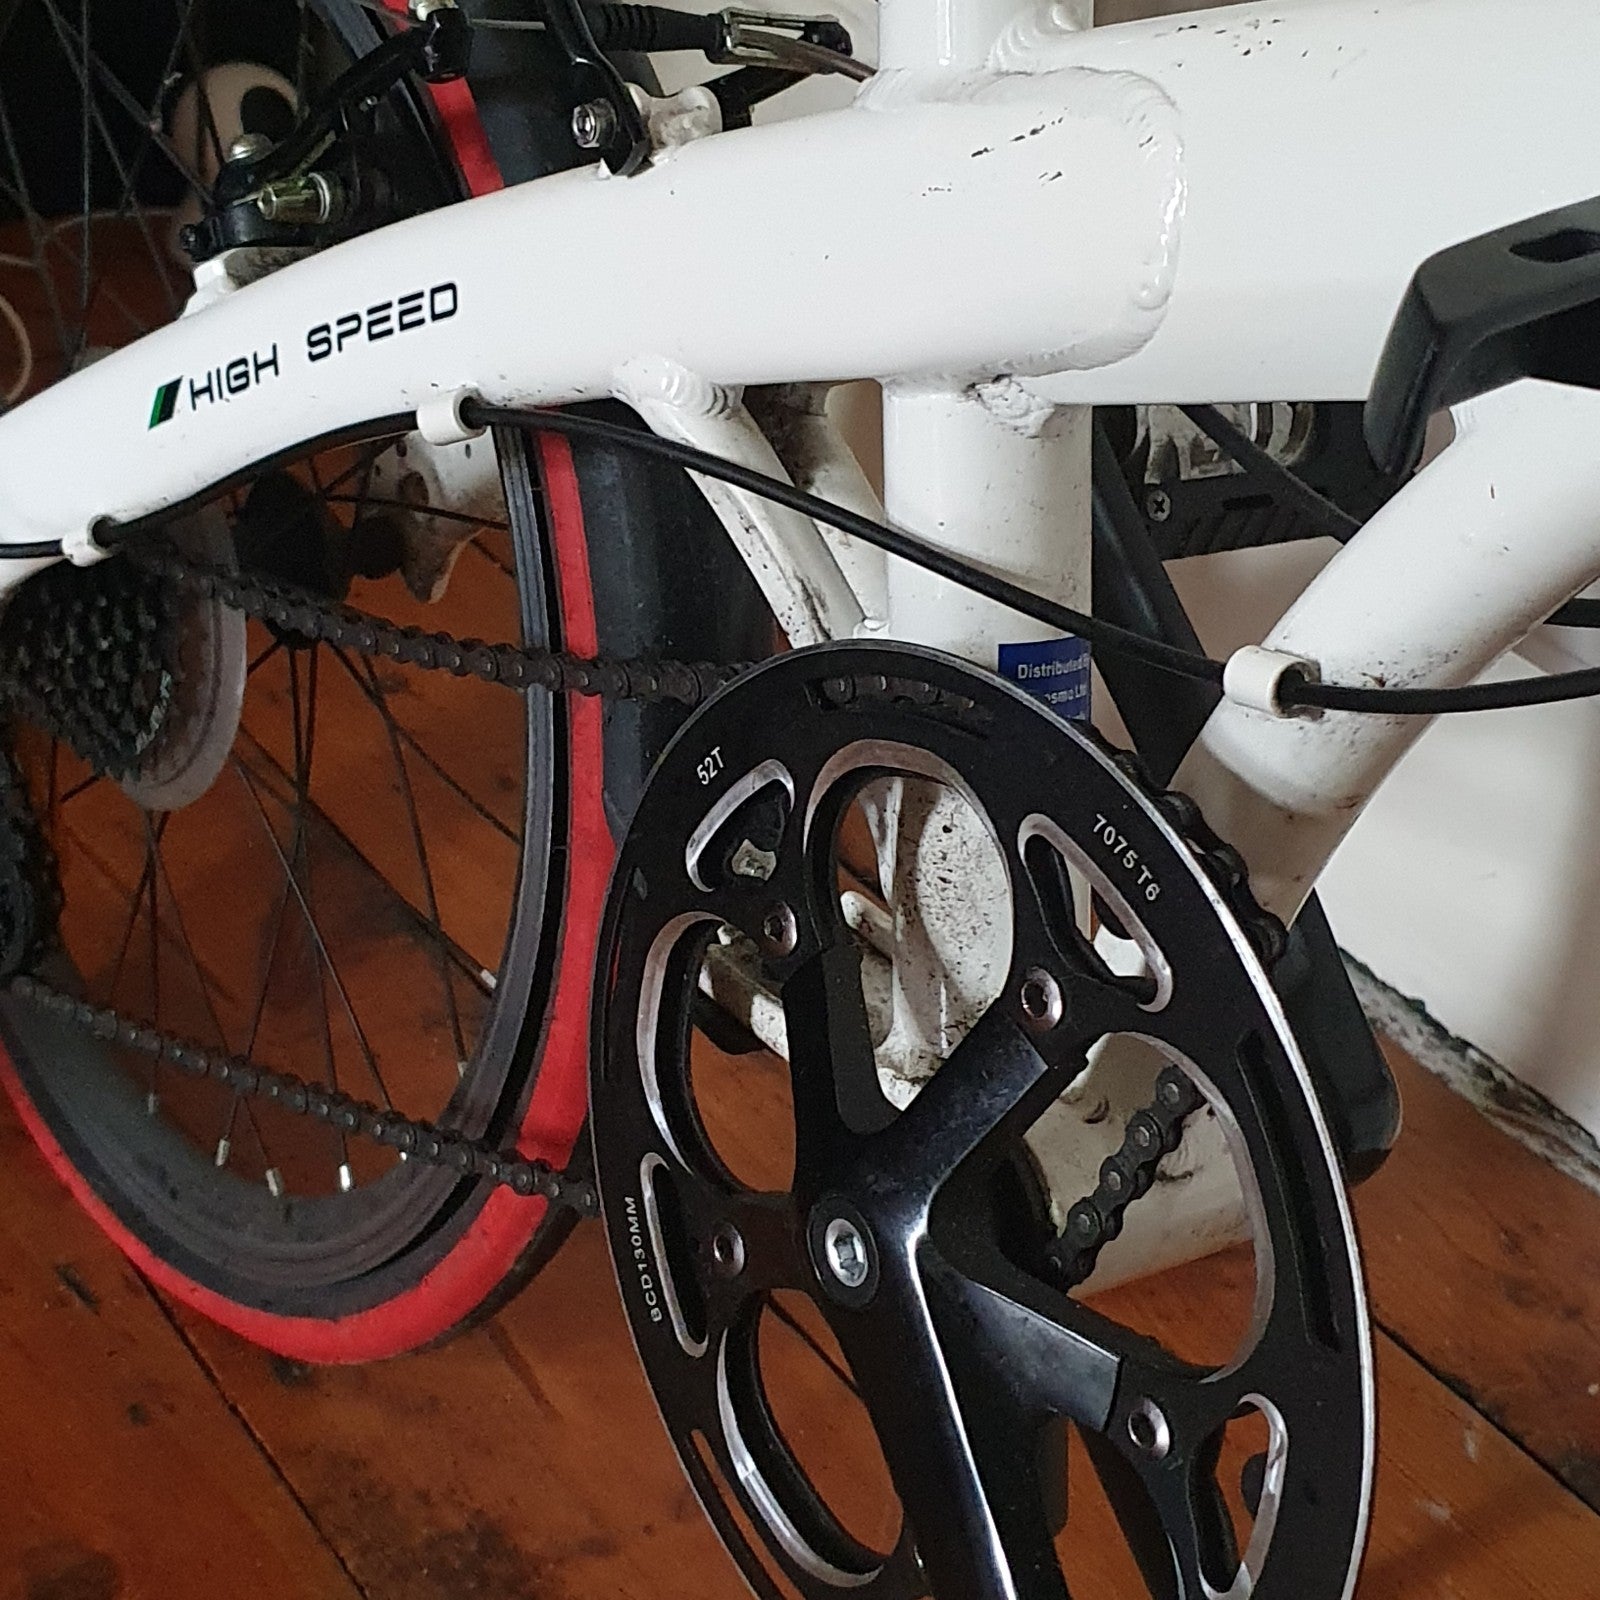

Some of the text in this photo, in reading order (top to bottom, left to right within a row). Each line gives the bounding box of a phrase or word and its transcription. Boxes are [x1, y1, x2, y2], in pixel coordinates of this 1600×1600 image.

[190, 281, 458, 410] HIGH SPEED
[696, 746, 724, 785] 52T
[1093, 813, 1161, 901] 7075 T6
